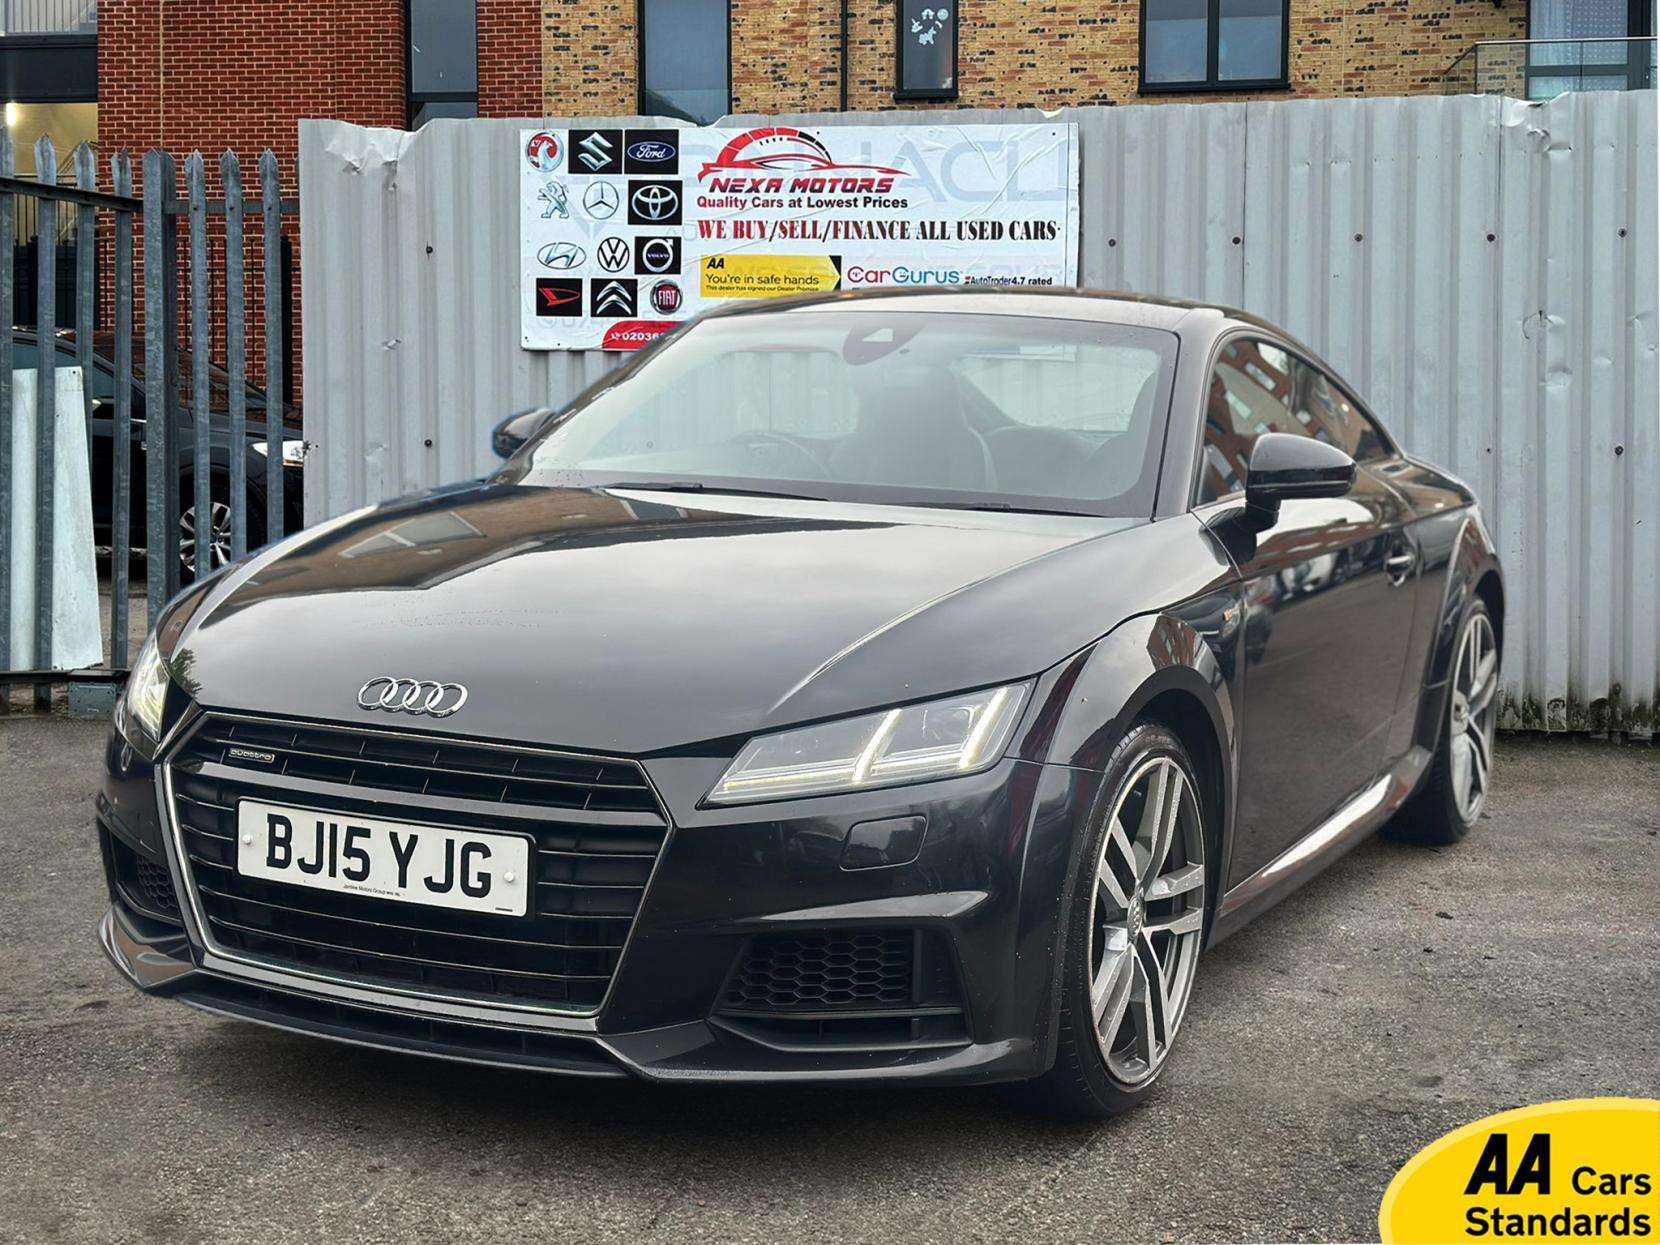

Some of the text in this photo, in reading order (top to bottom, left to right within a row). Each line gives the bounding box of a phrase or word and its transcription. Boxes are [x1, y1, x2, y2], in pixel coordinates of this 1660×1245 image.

[636, 144, 667, 159] Ford
[709, 177, 895, 194] NEXA MOTORS
[697, 196, 909, 211] Quality Cars at Lowest Prices
[697, 219, 728, 240] WE
[733, 219, 911, 243] BUY/SELL/FINANCE
[916, 220, 951, 241] ALL
[956, 220, 1004, 241] USED
[1008, 220, 1058, 241] CARS
[707, 257, 726, 270] AA
[706, 273, 820, 285] You're in safe hands
[847, 265, 960, 284] CarGurus
[1027, 276, 1053, 286] rated
[658, 289, 677, 305] FIAT
[230, 749, 272, 762] quattro
[266, 812, 493, 899] BJ15 YJG
